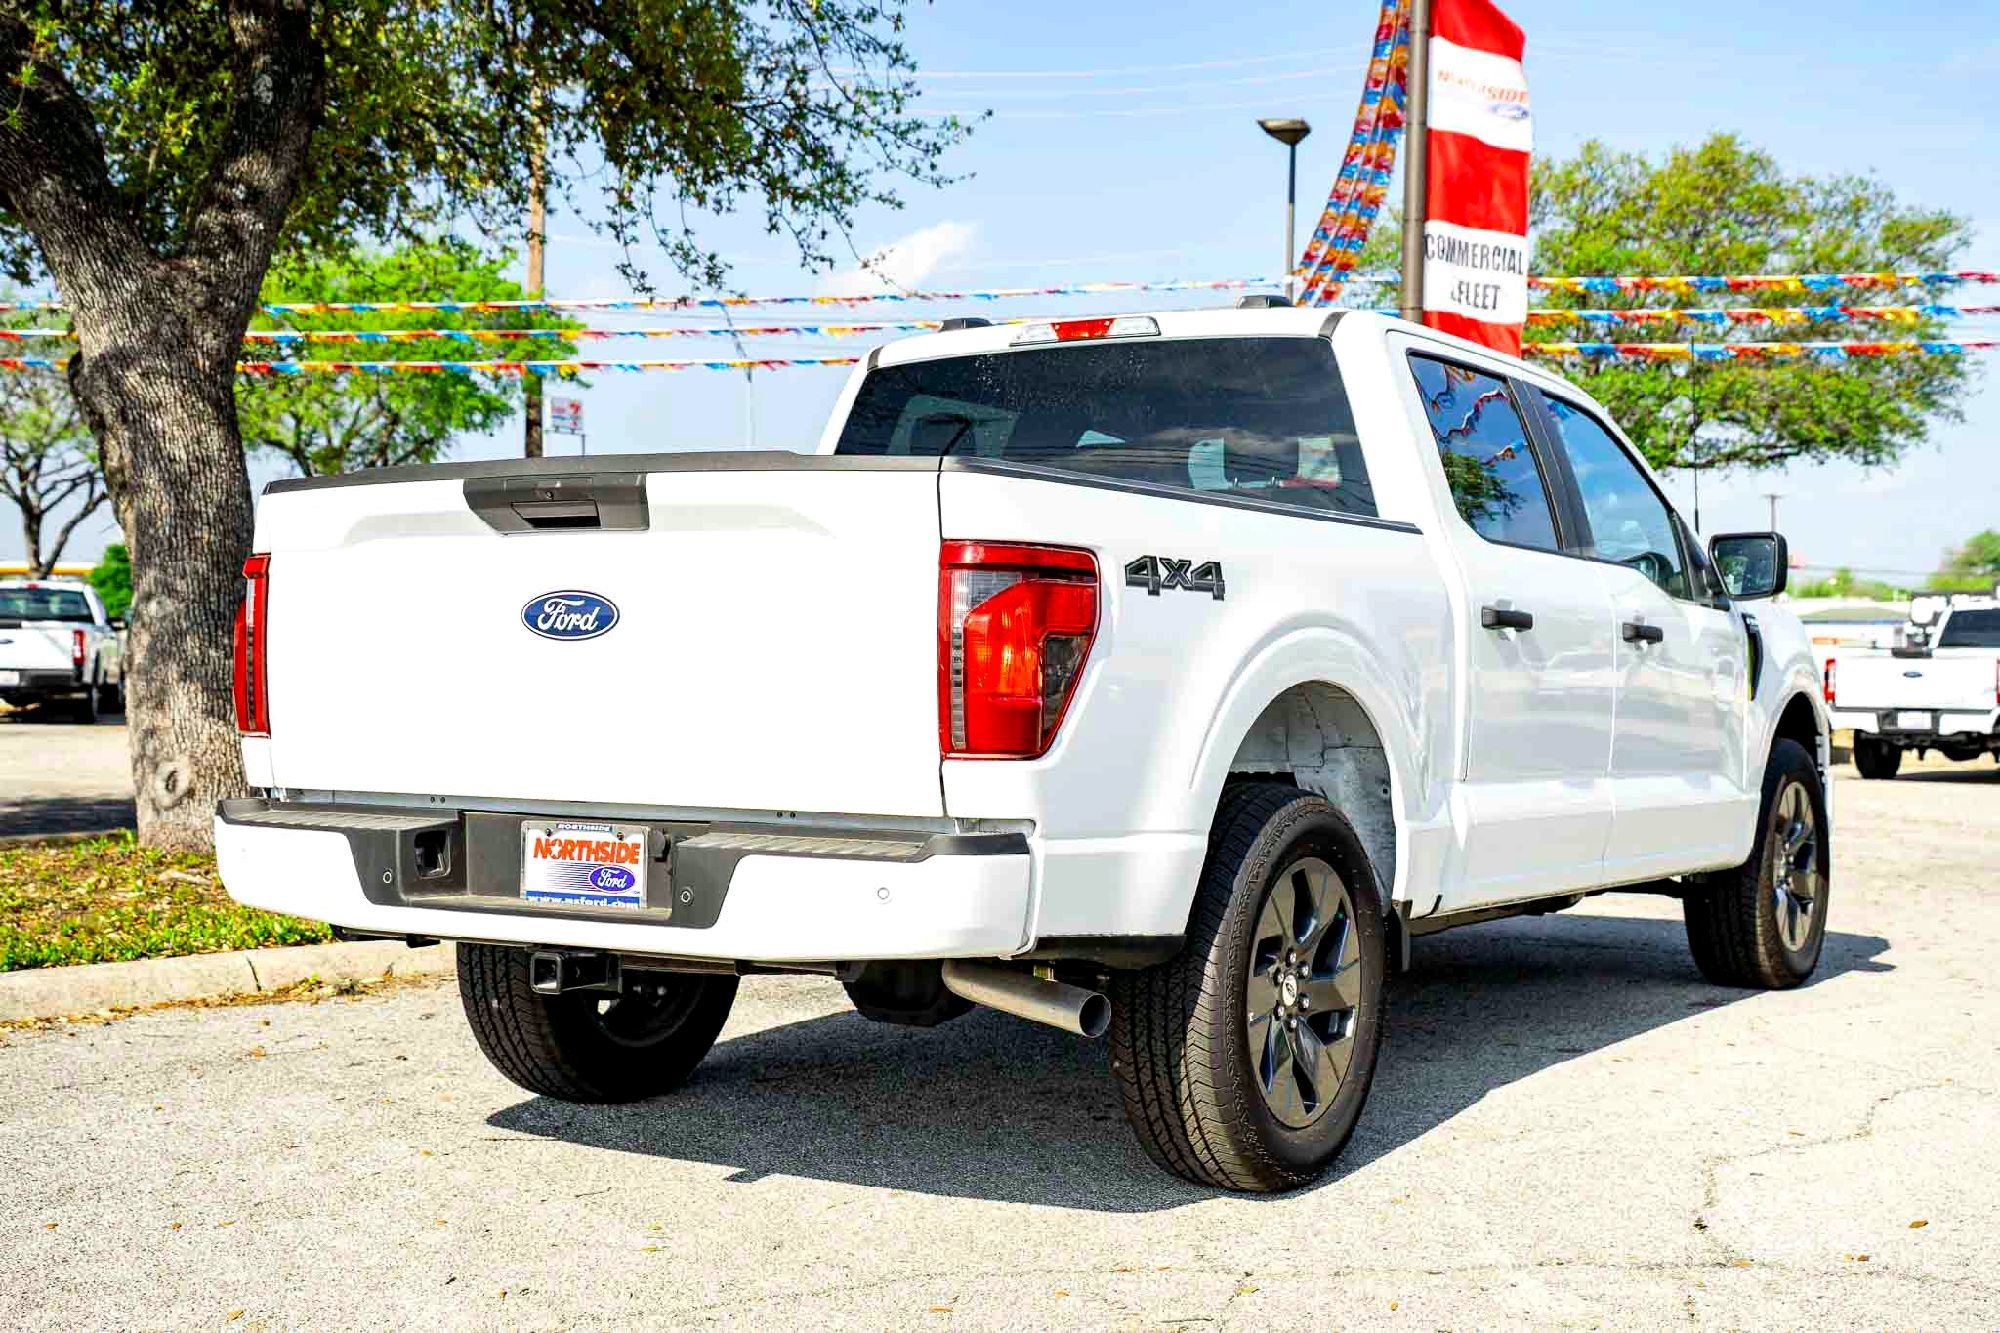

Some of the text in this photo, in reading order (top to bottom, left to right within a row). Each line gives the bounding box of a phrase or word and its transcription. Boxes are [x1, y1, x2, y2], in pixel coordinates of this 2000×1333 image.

[1424, 233, 1524, 275] COMMERCIAL
[537, 598, 601, 631] Ford
[533, 837, 641, 865] NORTHSIDE
[597, 868, 627, 889] Ford
